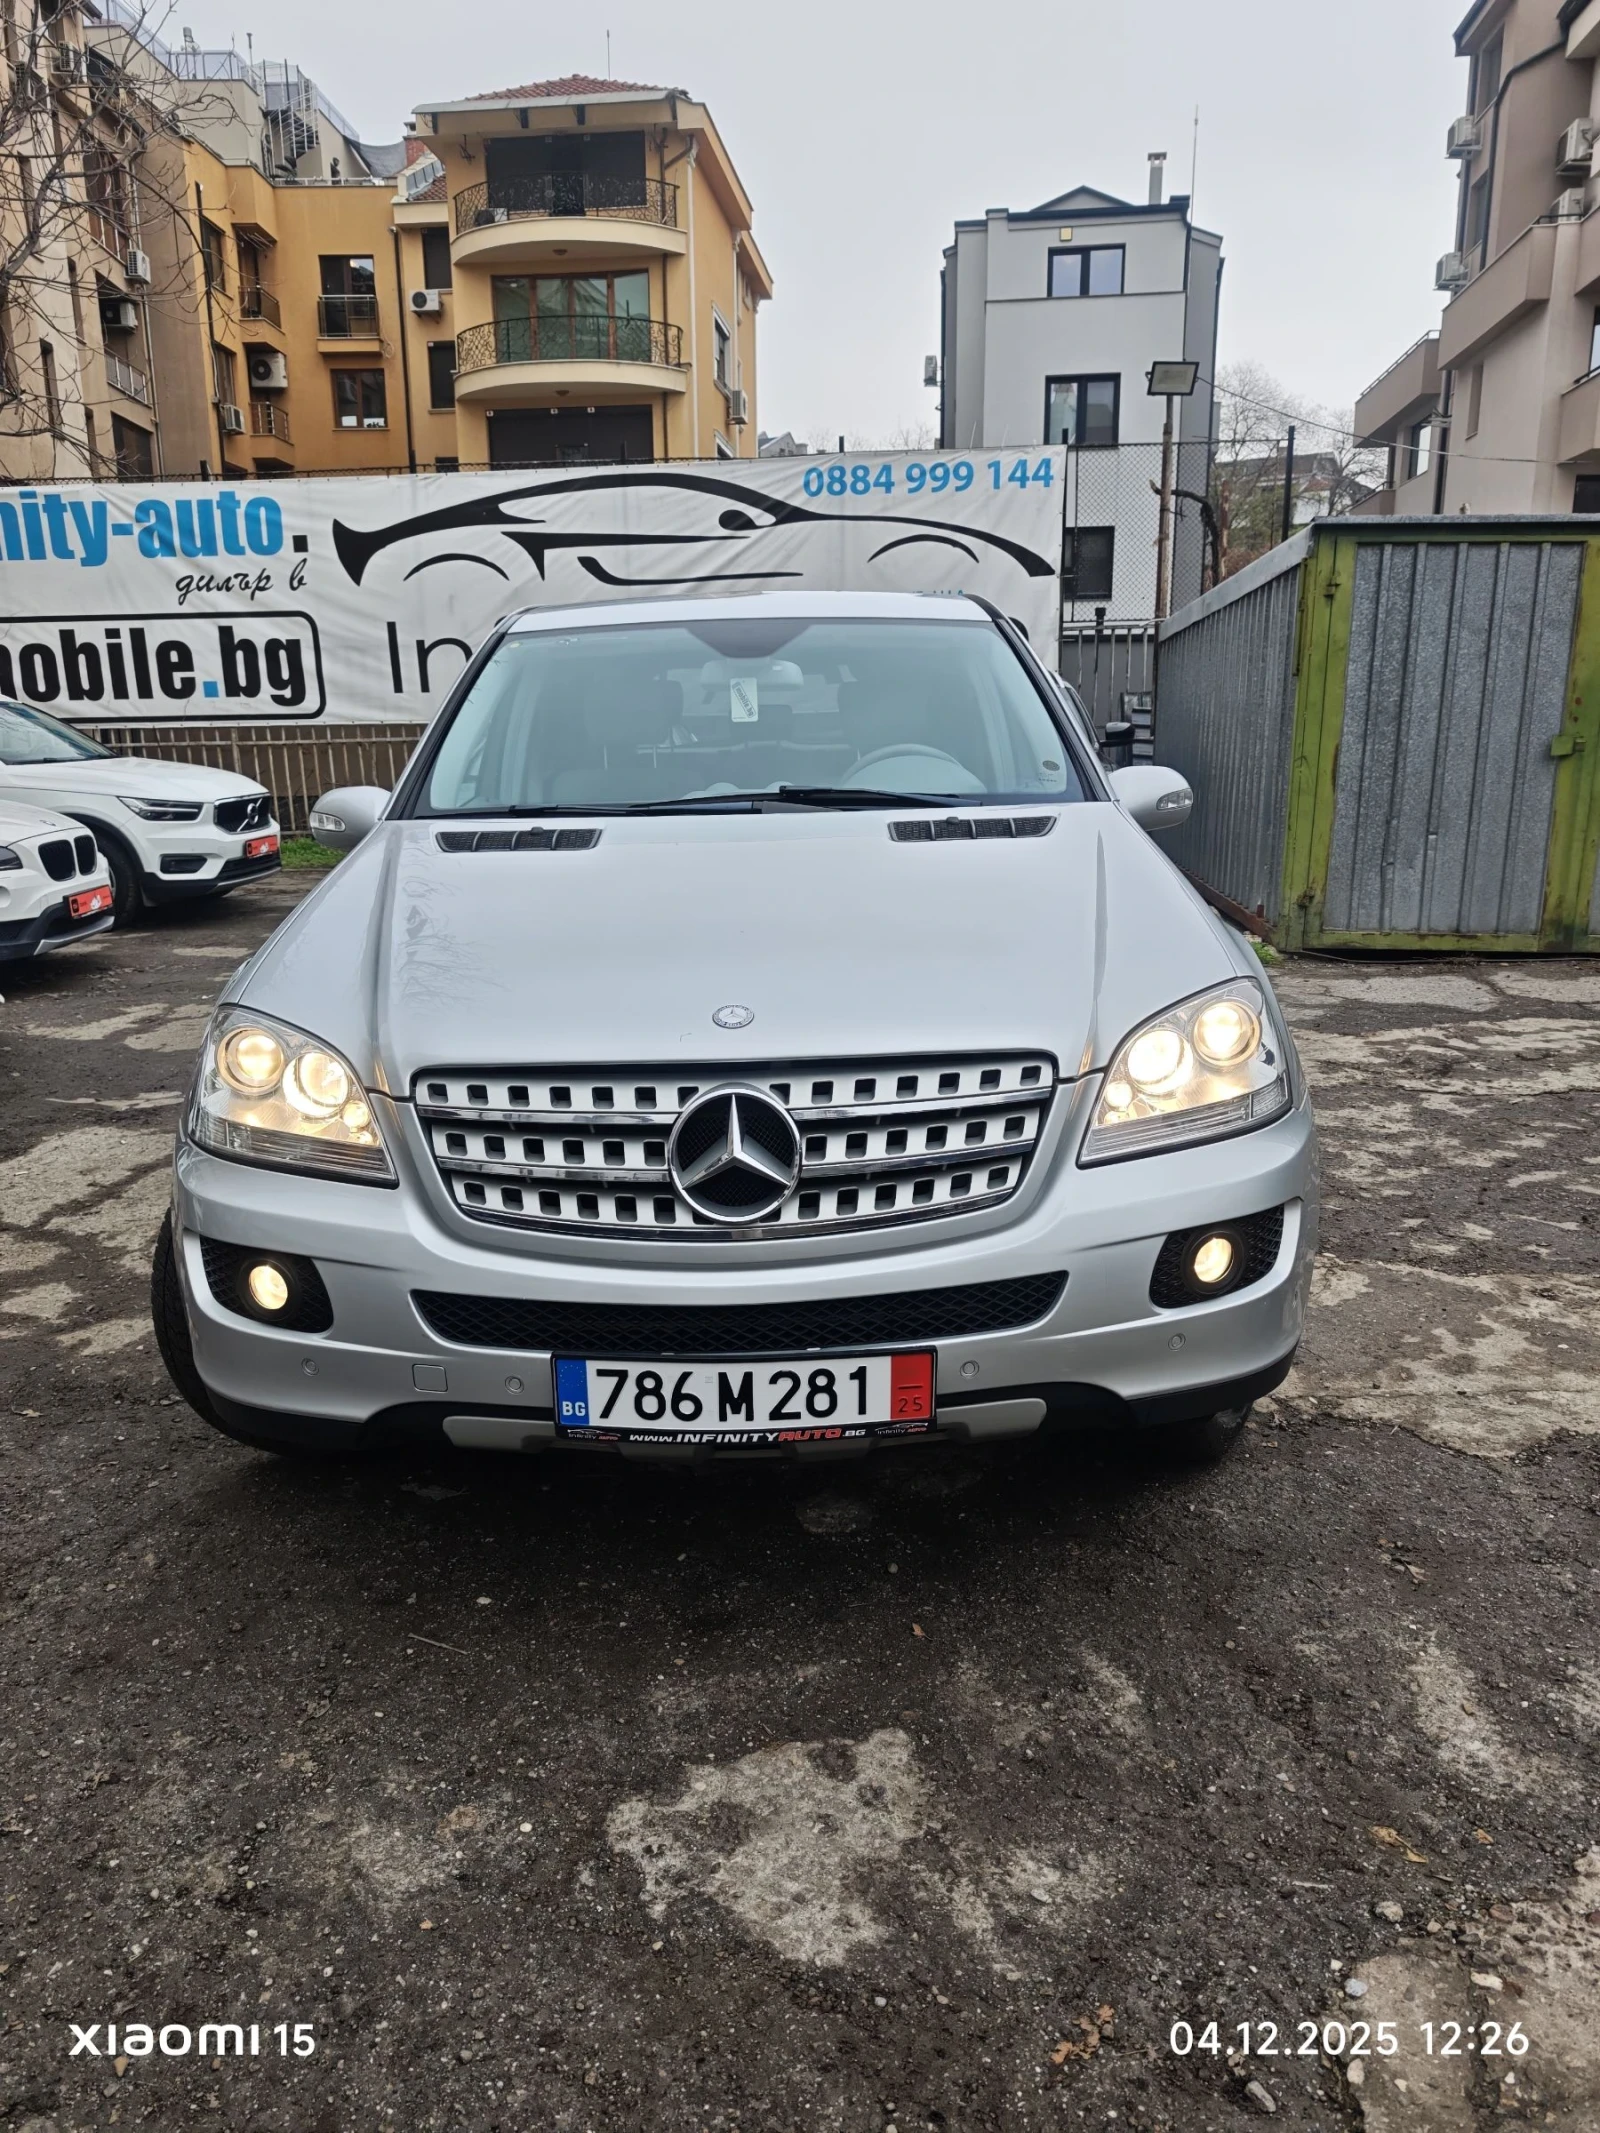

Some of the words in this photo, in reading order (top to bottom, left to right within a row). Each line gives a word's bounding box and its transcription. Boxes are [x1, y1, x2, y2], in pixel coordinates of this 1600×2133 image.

[803, 464, 895, 498] 0884
[905, 461, 974, 494] 999
[987, 457, 1054, 490] 144
[175, 568, 273, 605] дилър
[562, 1401, 586, 1417] BG
[596, 1369, 703, 1423] 786
[768, 1365, 868, 1420] 281
[897, 1396, 923, 1413] 25
